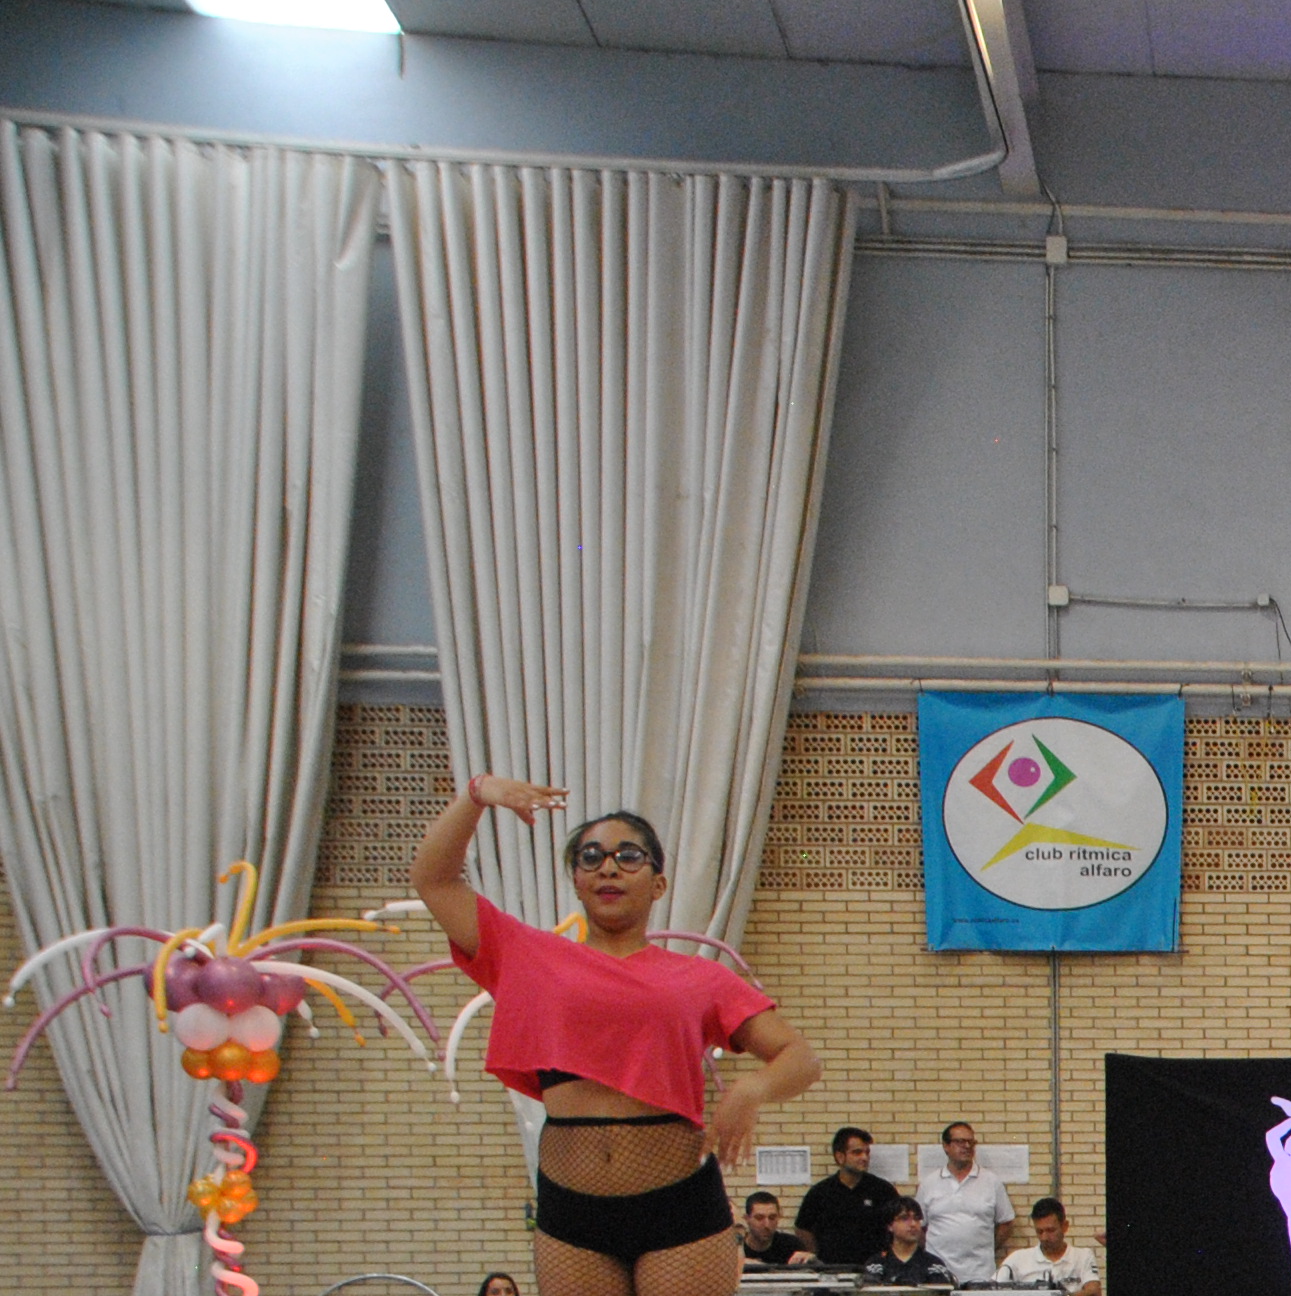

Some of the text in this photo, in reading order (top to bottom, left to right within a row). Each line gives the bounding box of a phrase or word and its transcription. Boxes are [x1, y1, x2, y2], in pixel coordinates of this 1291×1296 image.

[1025, 847, 1132, 861] club rítmica
[1080, 864, 1132, 877] alfaro
